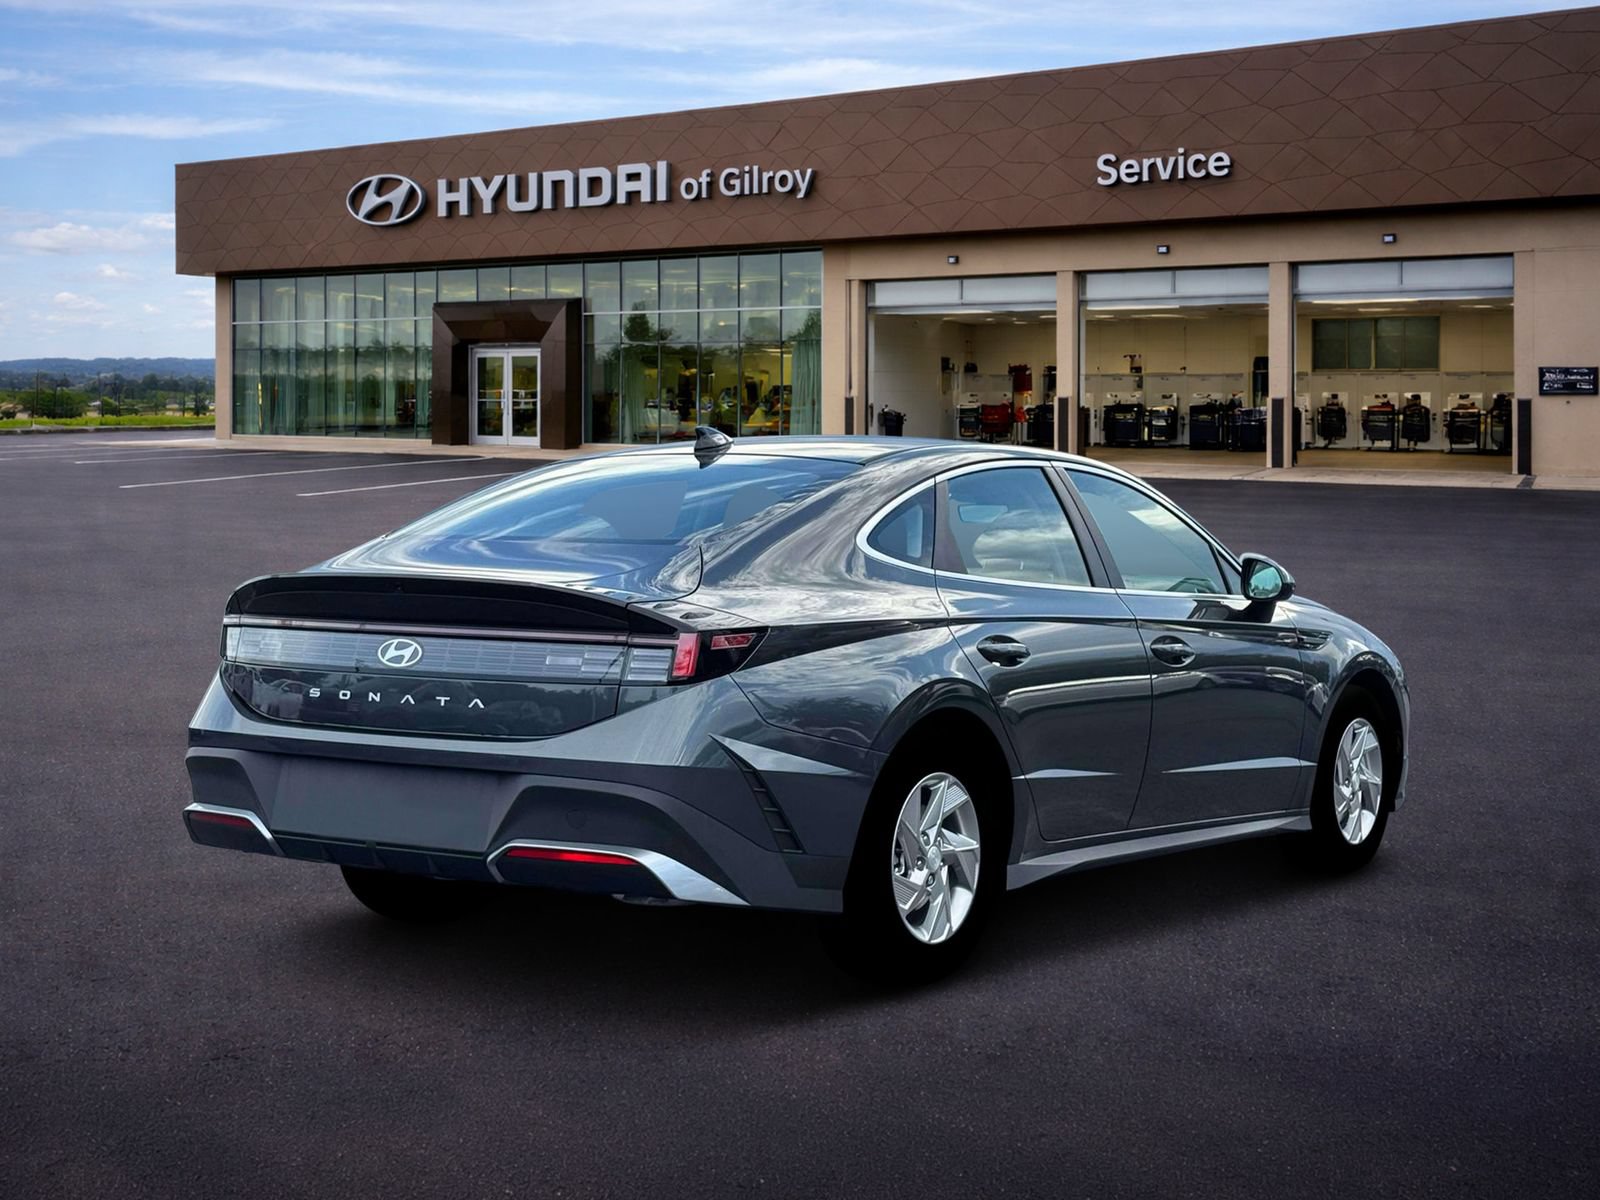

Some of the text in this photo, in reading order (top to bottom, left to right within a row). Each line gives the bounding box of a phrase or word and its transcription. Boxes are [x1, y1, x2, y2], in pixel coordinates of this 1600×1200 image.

[1096, 147, 1231, 186] Service
[437, 160, 669, 217] HYUNDAI
[680, 172, 711, 200] of
[719, 165, 813, 199] Gilroy
[308, 688, 485, 709] SONATA
